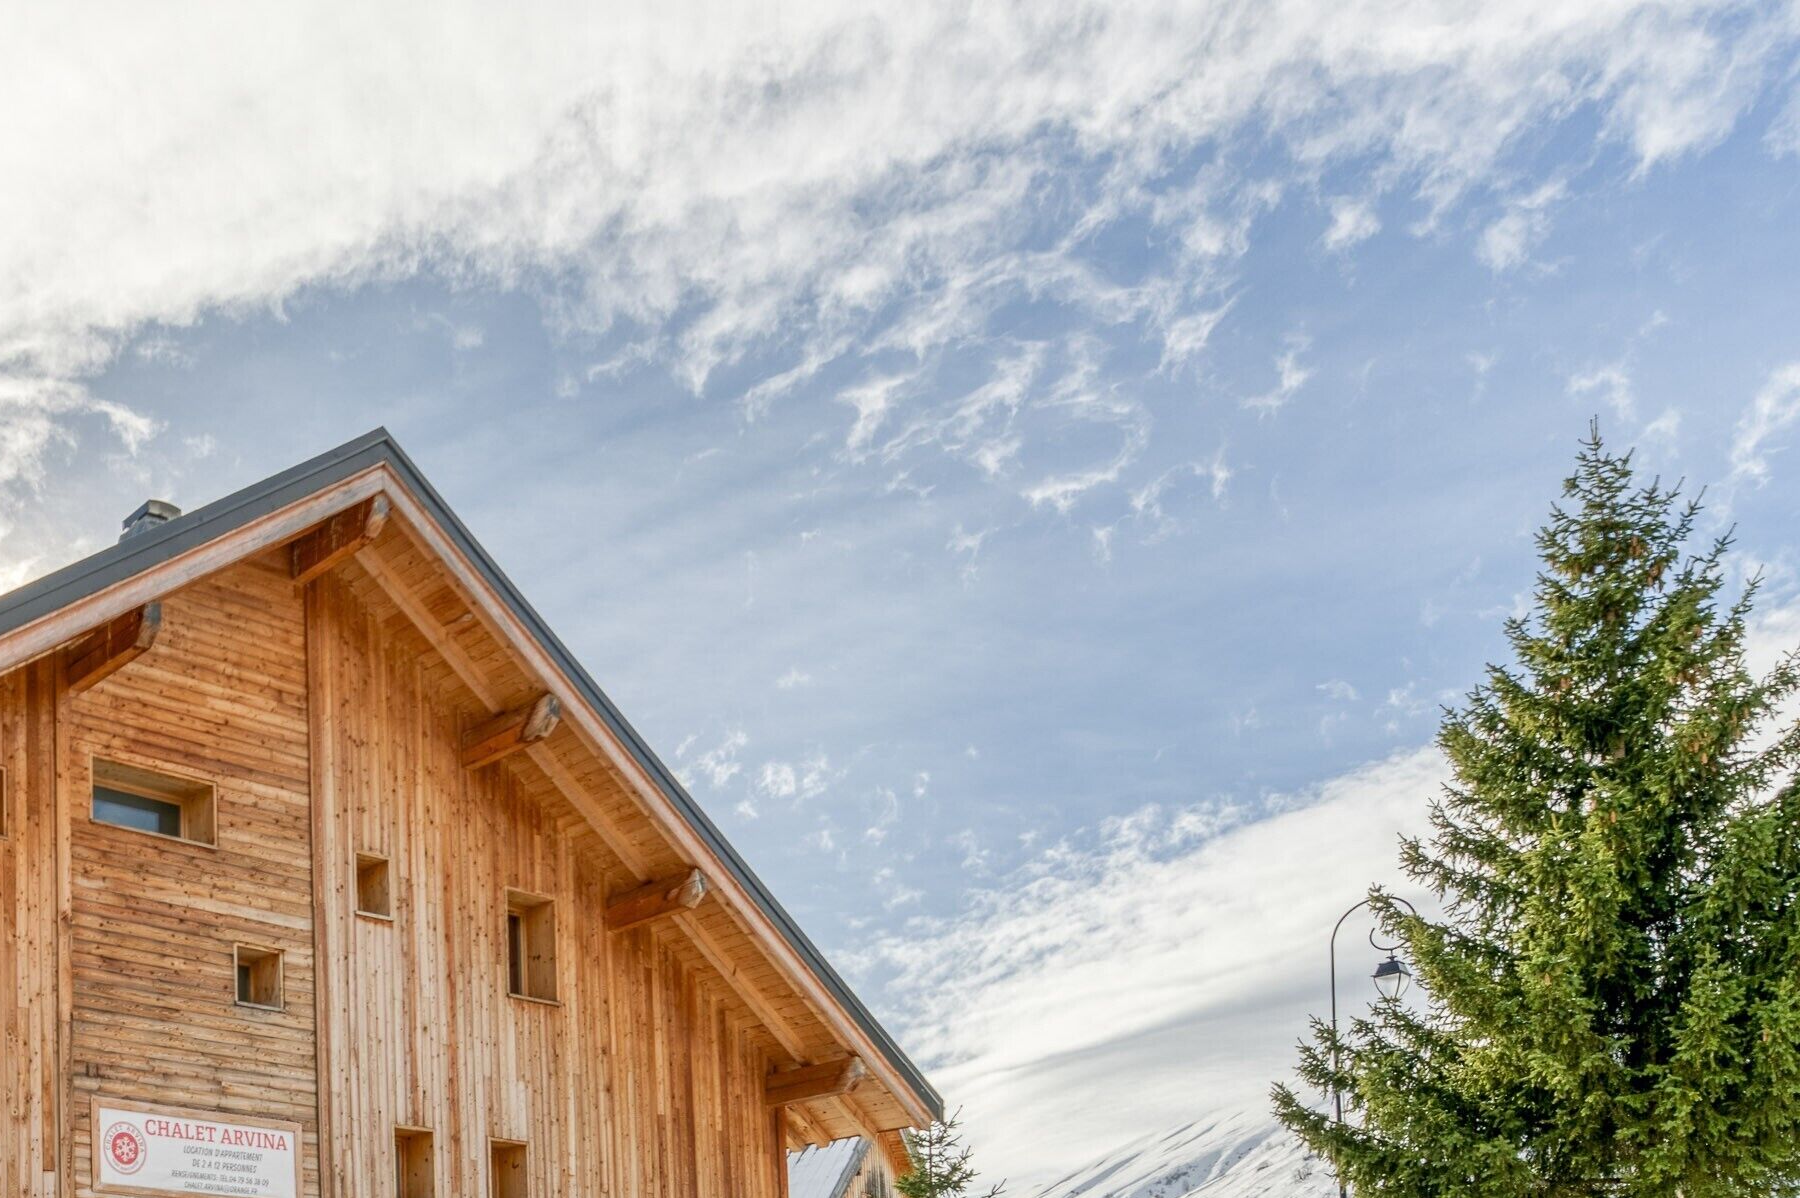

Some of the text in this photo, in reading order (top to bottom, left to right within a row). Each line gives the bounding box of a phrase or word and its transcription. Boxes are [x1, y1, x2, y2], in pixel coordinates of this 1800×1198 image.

[145, 1119, 288, 1150] CHALET ARVINA
[183, 1145, 213, 1156] LOCATION
[192, 1158, 200, 1168] DE
[201, 1159, 206, 1168] 2
[222, 1162, 257, 1173] PERSONNES
